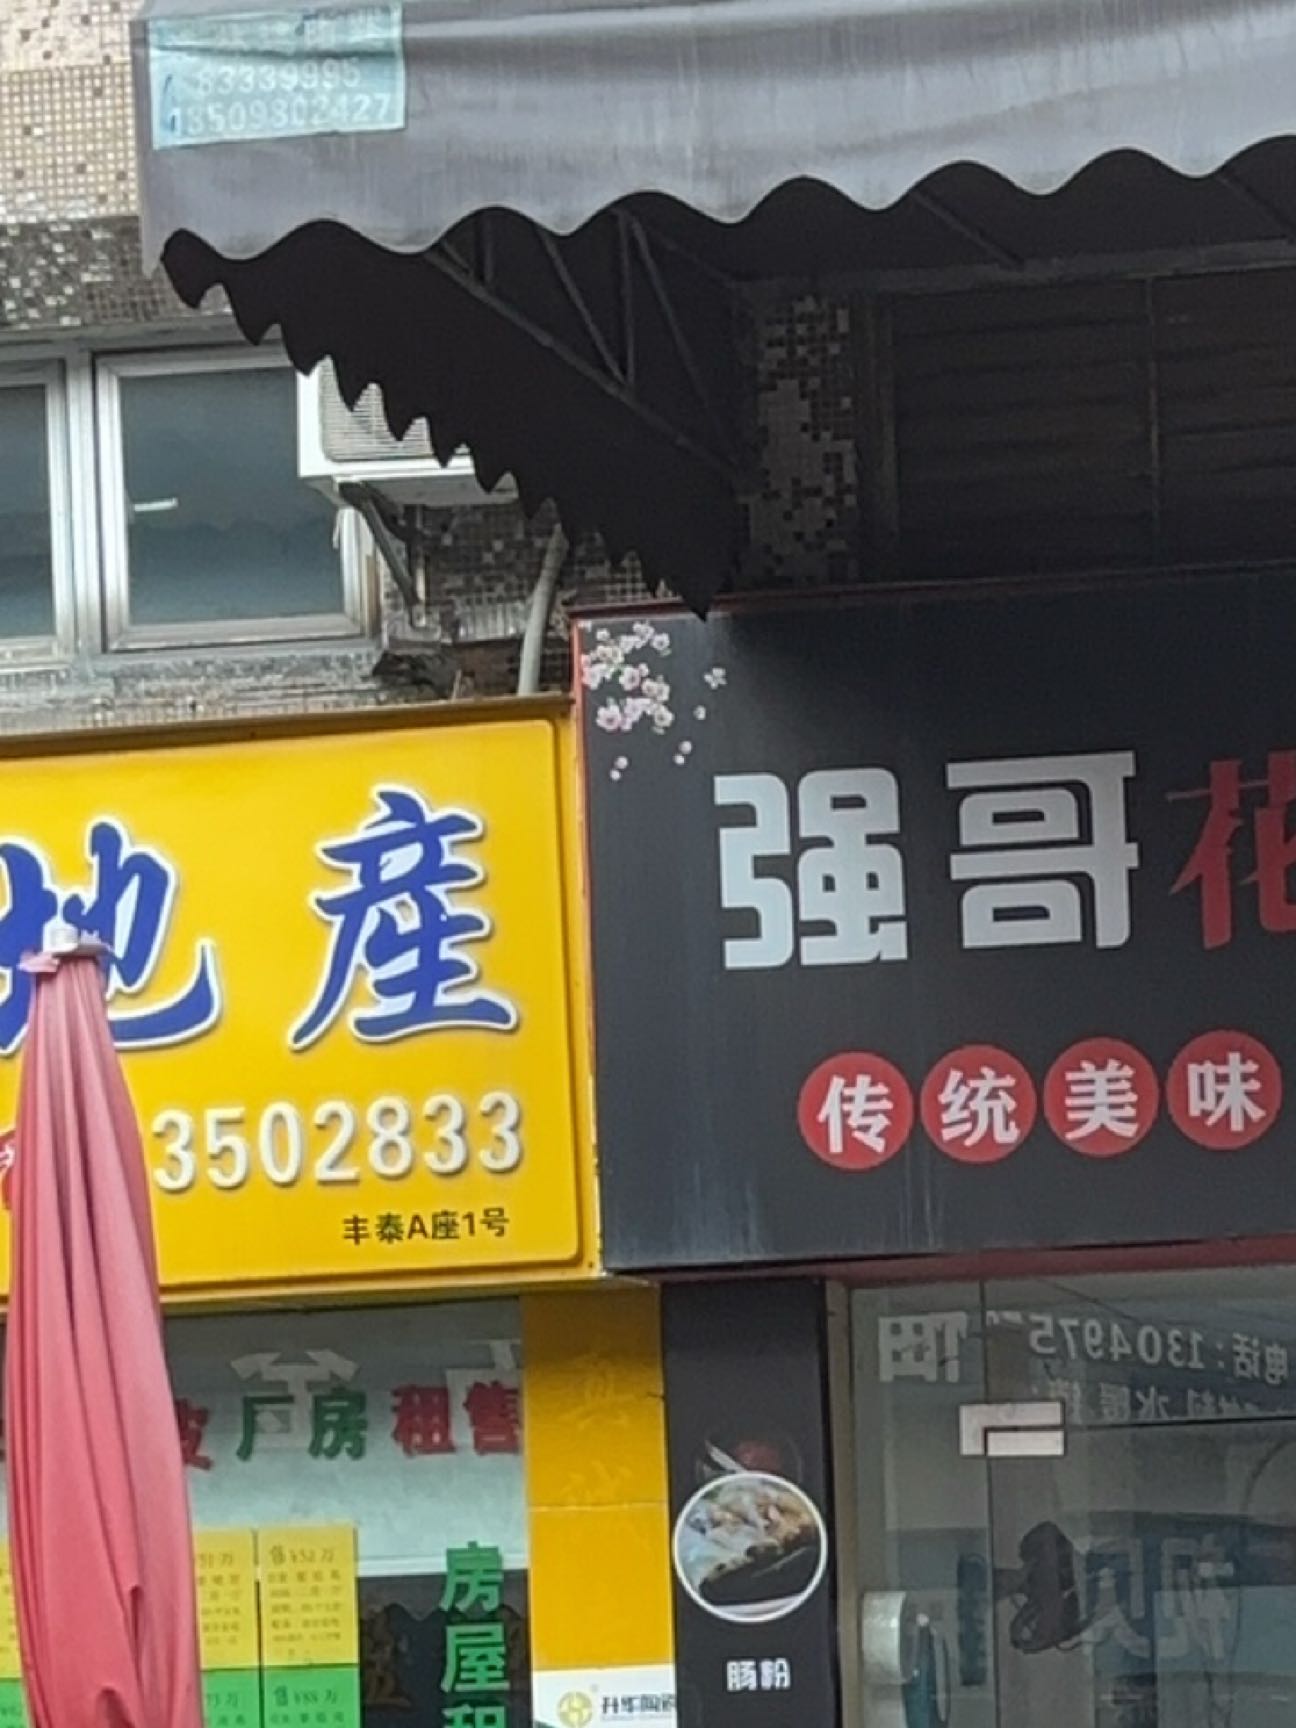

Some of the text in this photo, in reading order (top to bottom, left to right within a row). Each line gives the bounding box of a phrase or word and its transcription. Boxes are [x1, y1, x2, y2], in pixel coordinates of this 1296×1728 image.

[152, 1091, 524, 1192] 3502833
[816, 1051, 1267, 1155] 传统美味
[342, 1207, 510, 1245] 丰泰A座1号
